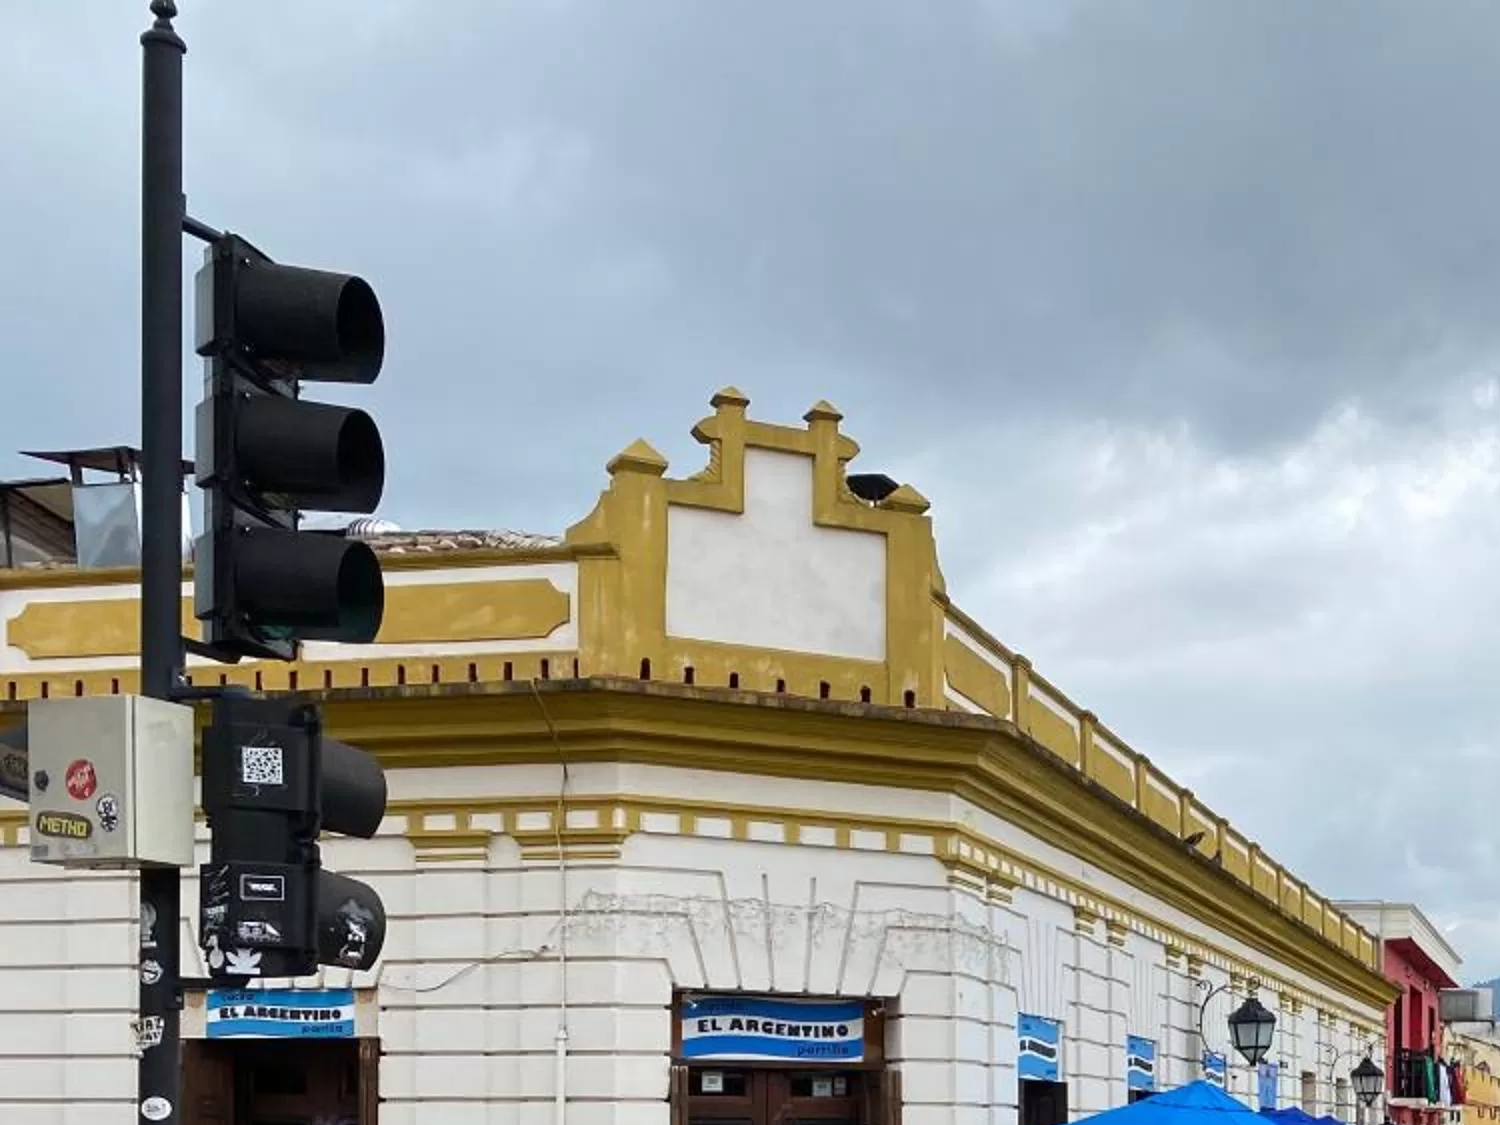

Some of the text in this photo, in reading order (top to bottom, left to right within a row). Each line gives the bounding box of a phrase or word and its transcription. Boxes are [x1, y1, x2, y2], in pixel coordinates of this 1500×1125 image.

[219, 1005, 342, 1022] EL ARGENTINO
[697, 1017, 849, 1039] EL ARGENTINO
